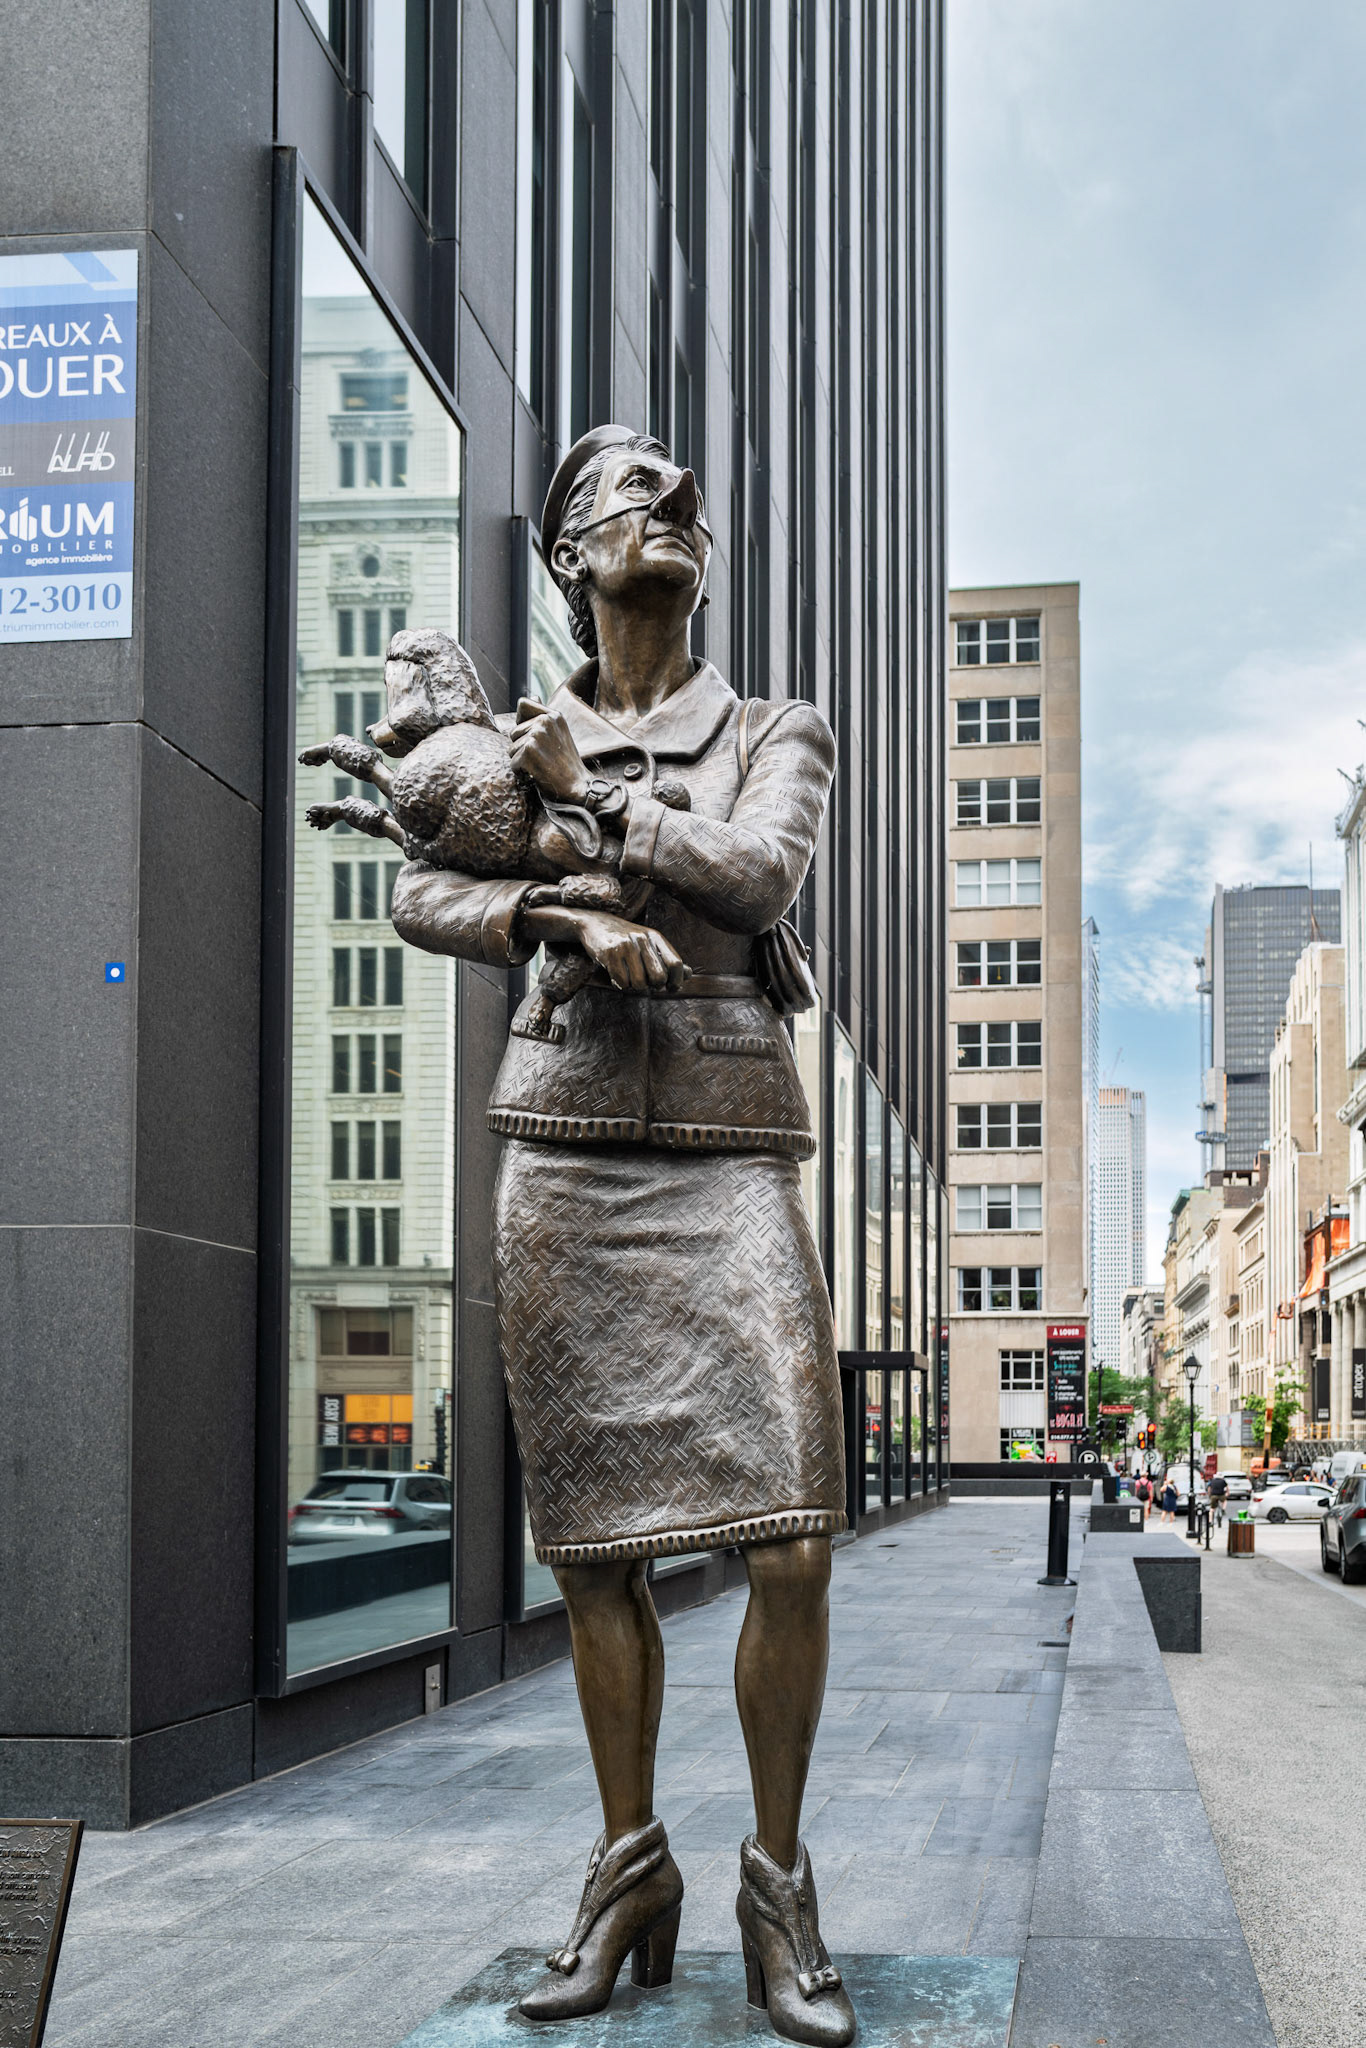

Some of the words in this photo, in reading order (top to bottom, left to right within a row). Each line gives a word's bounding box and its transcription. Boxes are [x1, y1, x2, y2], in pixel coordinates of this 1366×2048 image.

[98, 313, 123, 345] À
[25, 556, 60, 567] agence
[61, 553, 113, 564] immobilière
[1059, 1328, 1080, 1336] LOUER
[1354, 1363, 1365, 1399] artopex
